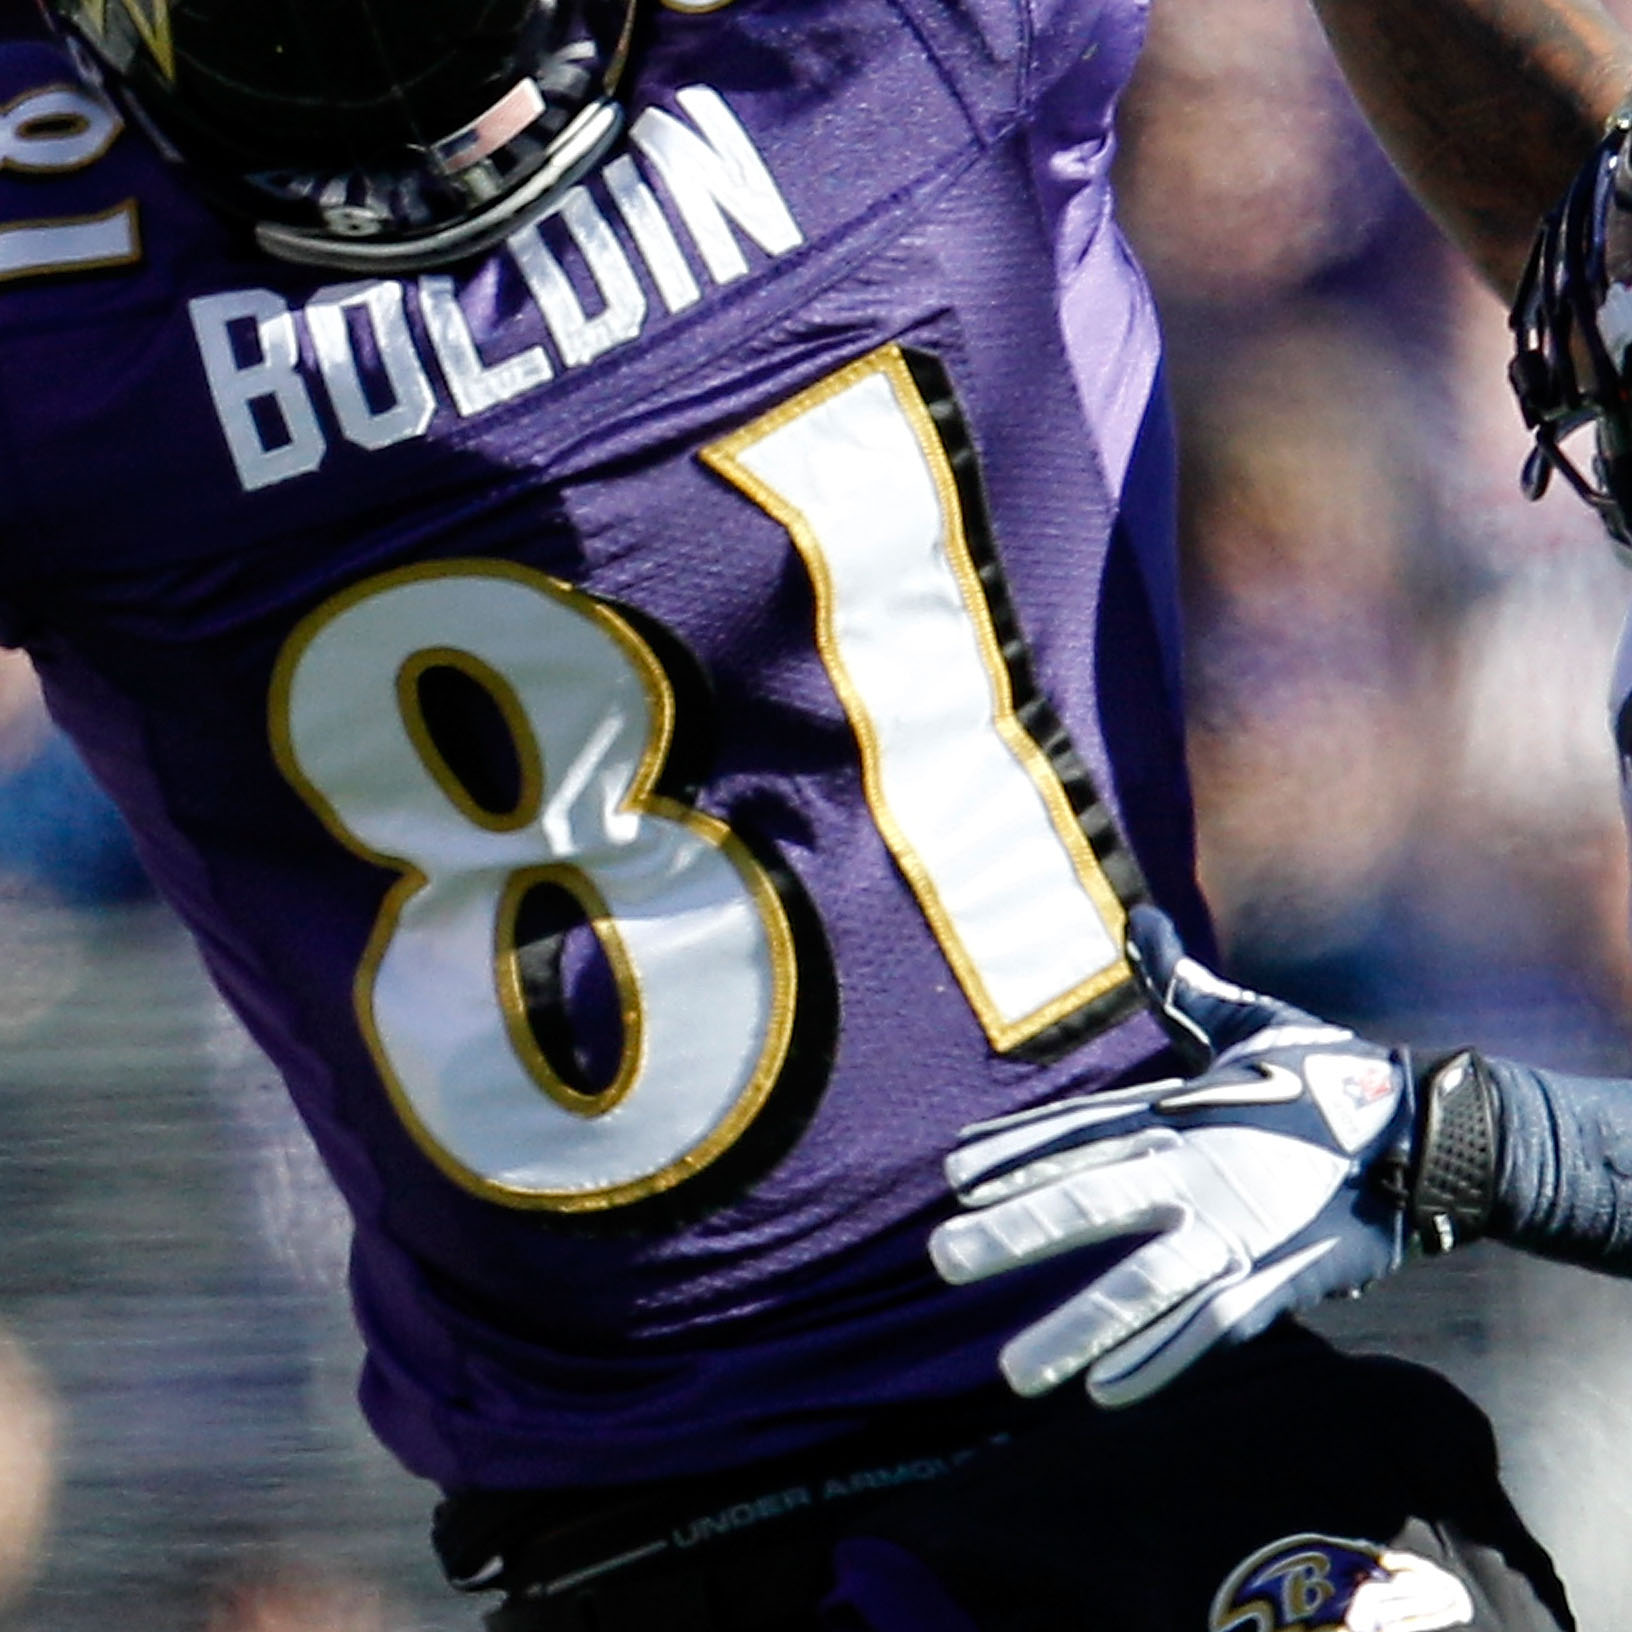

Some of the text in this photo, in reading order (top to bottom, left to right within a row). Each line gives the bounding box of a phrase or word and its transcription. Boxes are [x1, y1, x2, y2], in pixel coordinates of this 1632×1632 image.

[187, 84, 805, 493] BOLDIN
[266, 343, 1141, 1216] 81
[671, 1485, 814, 1549] UNDER
